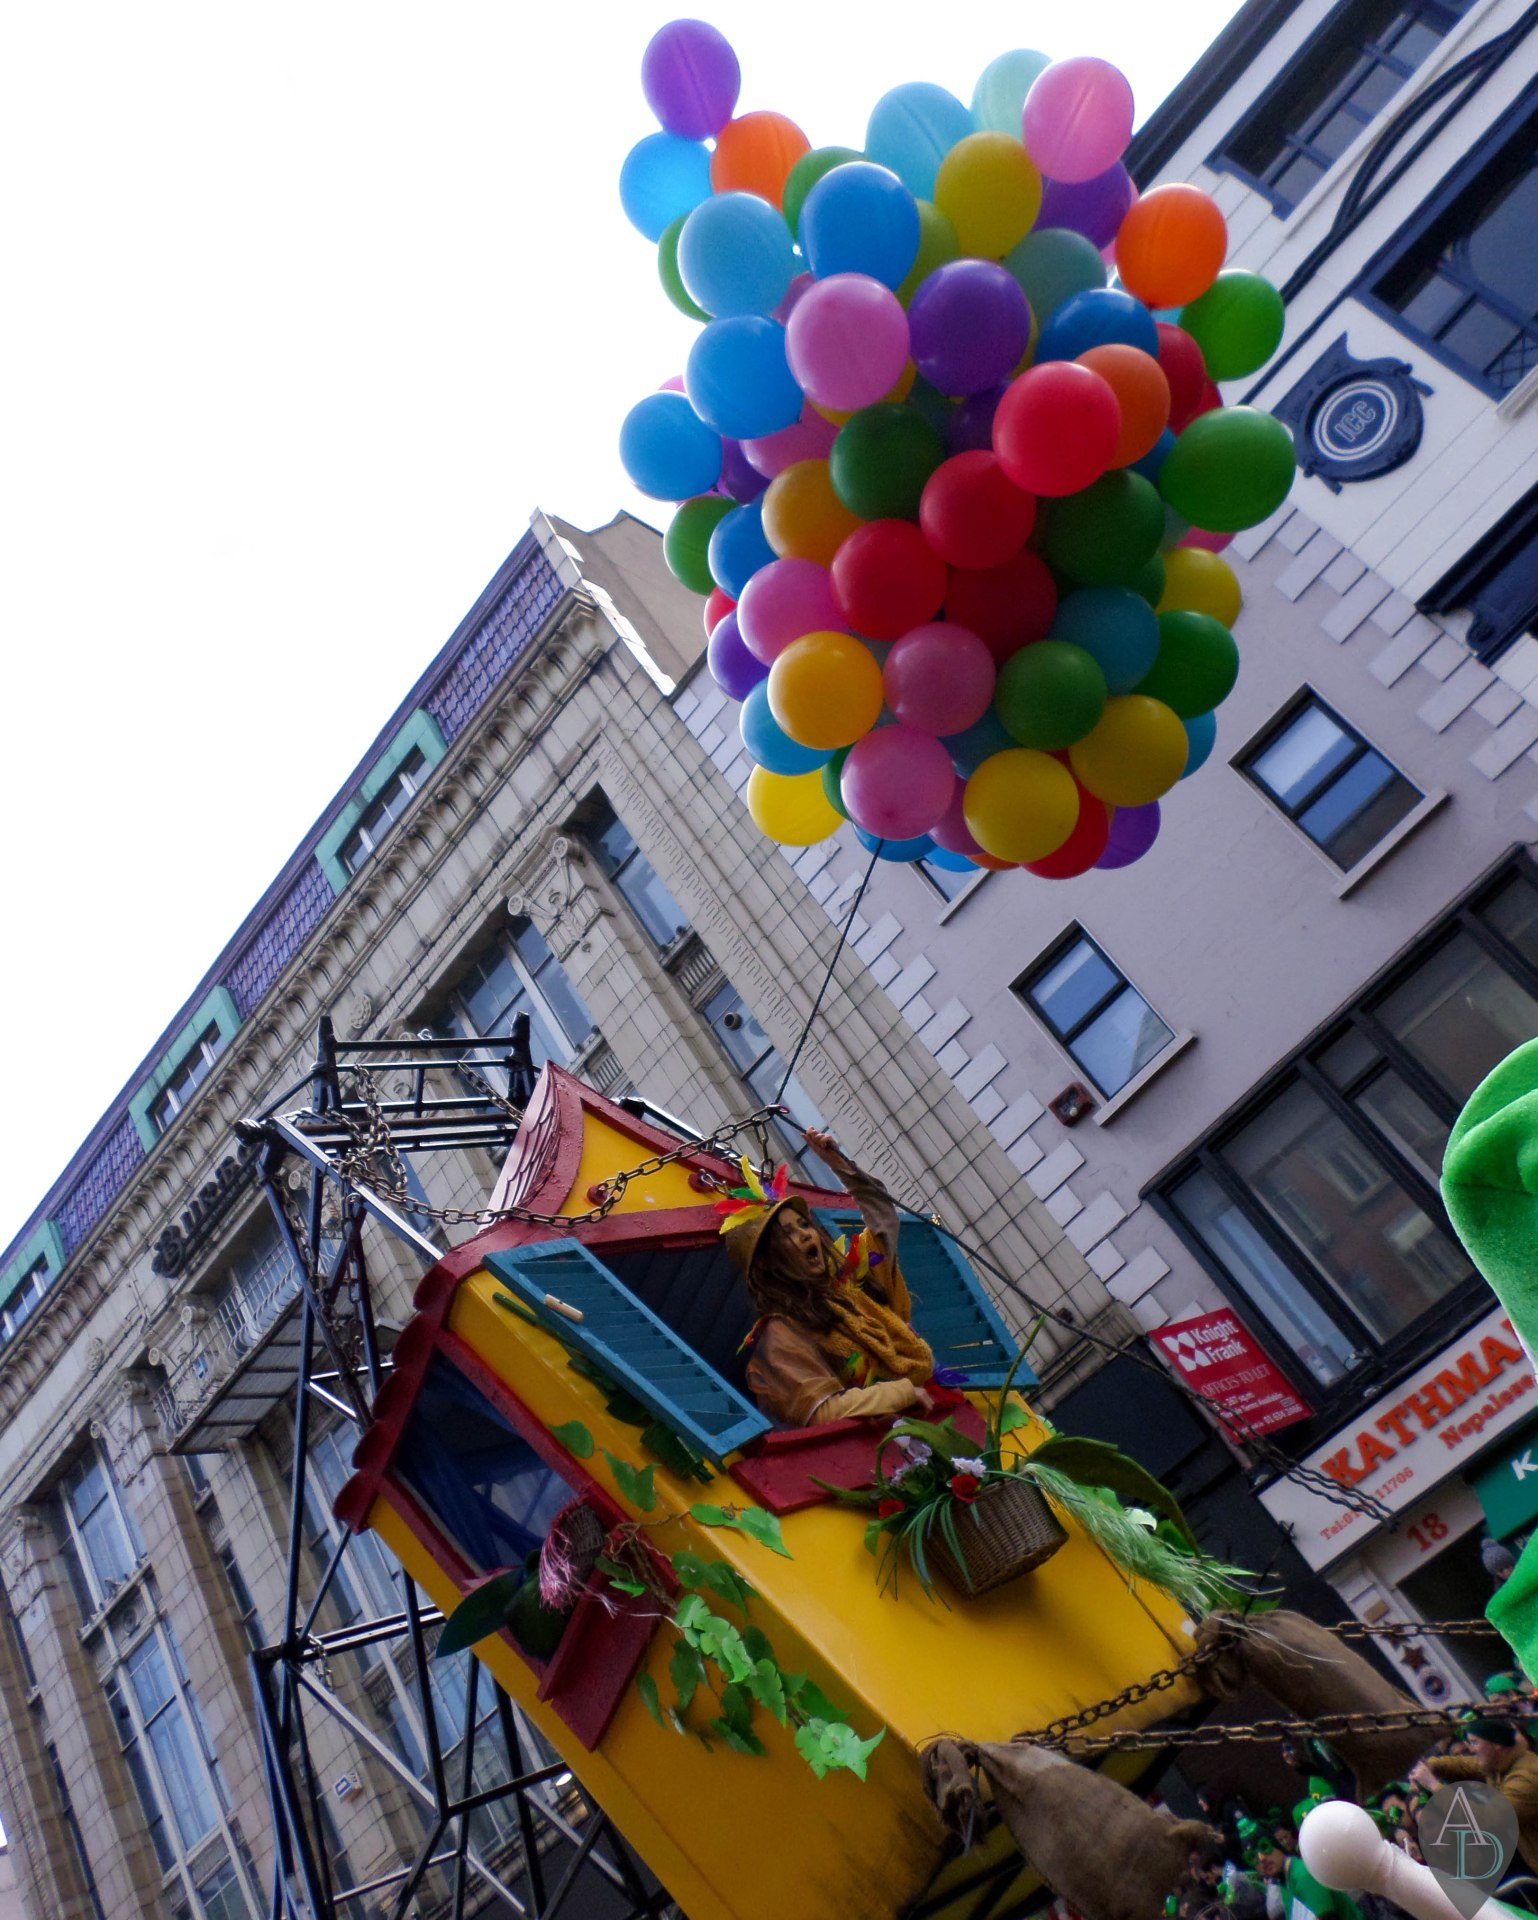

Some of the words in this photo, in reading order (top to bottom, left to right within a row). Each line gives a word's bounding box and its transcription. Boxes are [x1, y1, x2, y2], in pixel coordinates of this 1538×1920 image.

[1334, 400, 1377, 443] ICC
[1190, 1319, 1239, 1344] Knight
[1205, 1339, 1247, 1362] Frank
[1201, 1376, 1239, 1396] OFFICES
[1237, 1370, 1254, 1385] TO
[1251, 1364, 1271, 1381] LET
[1320, 1318, 1525, 1488] KATHMA
[1407, 1511, 1449, 1551] 18
